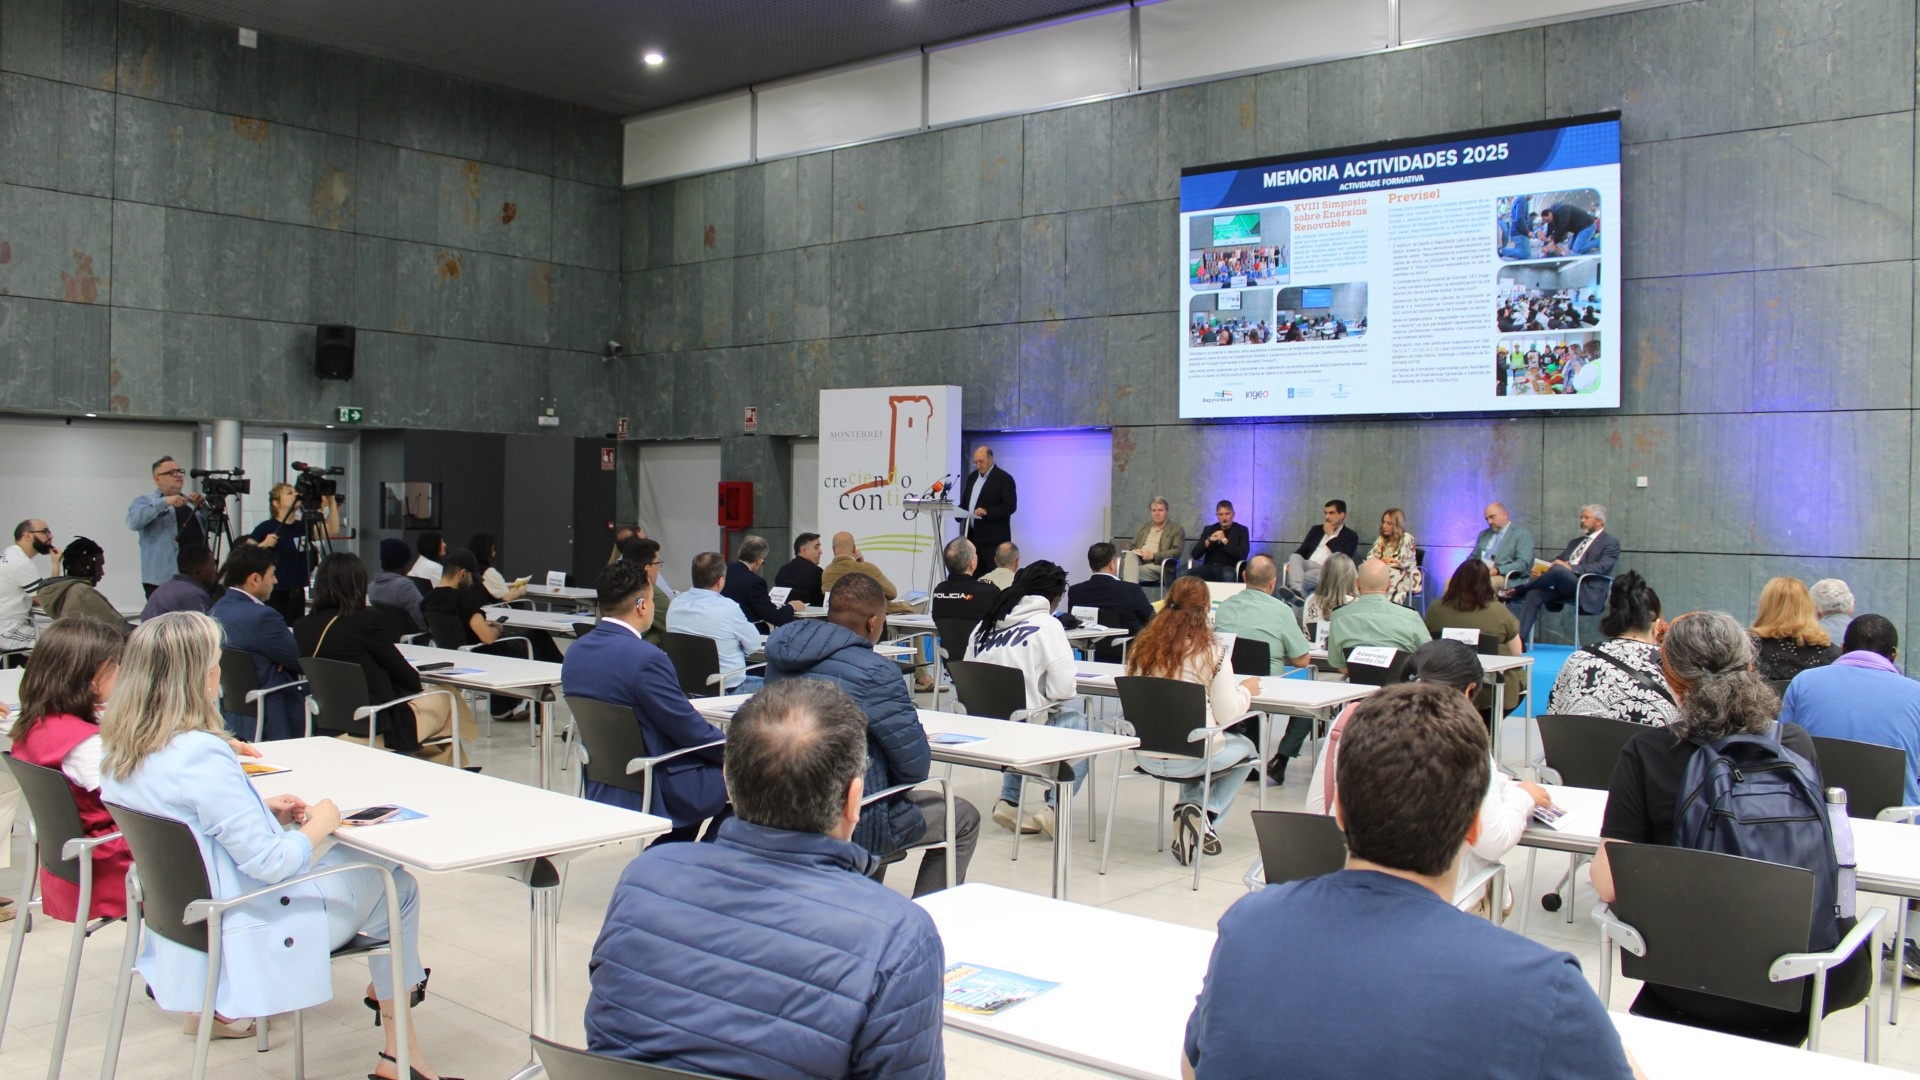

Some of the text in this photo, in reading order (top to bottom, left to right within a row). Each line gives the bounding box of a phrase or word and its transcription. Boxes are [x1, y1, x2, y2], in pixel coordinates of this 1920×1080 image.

[1263, 142, 1509, 189] MEMORIA ACTIVIDADES 2025
[1338, 174, 1425, 192] ACTIVIDADE FORMATIVA
[1388, 188, 1440, 203] Previsel
[1294, 197, 1367, 213] XVIII Simposio
[1294, 212, 1321, 222] sobre
[1294, 218, 1351, 232] Renovables
[830, 430, 883, 439] MONTERREI
[824, 465, 912, 489] creciendo
[1356, 651, 1389, 660] Reservado
